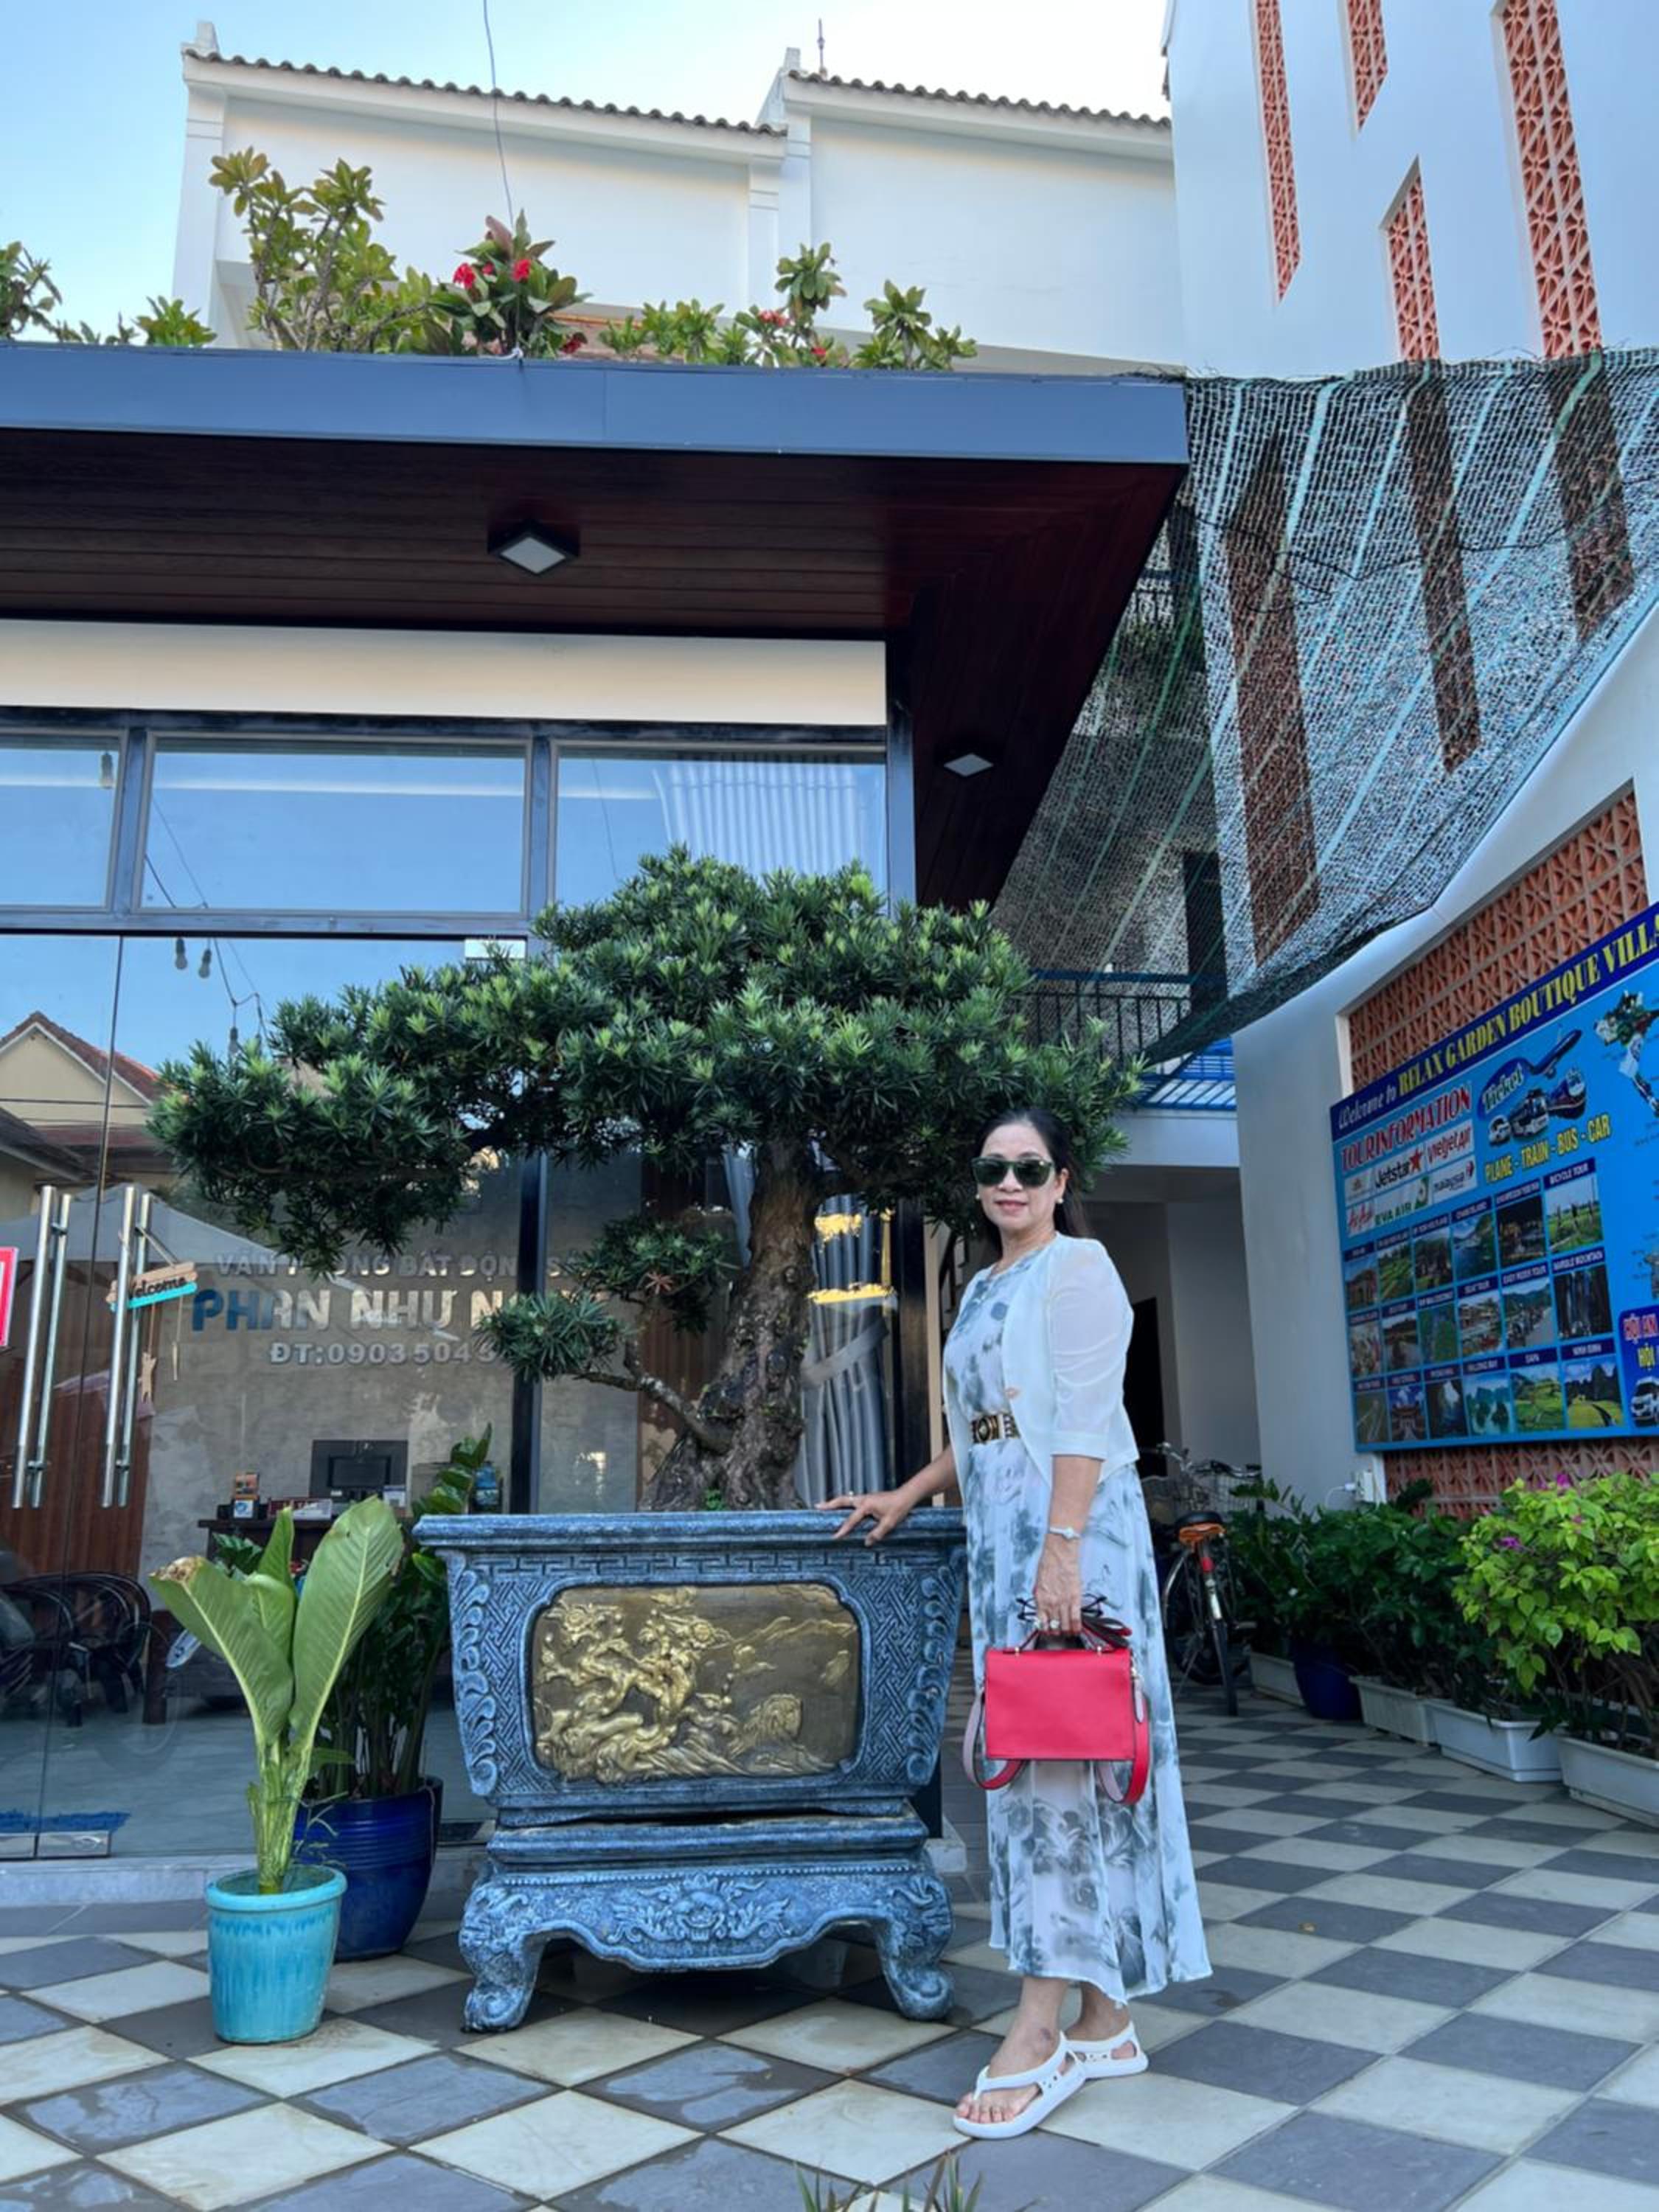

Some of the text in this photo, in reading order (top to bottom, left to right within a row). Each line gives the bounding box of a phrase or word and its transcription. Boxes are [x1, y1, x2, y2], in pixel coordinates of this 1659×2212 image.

[1399, 1050, 1444, 1096] RELAX
[1445, 1011, 1506, 1068] GARDEN
[1509, 953, 1601, 1032] BOUTIQUE
[1482, 1062, 1525, 1114] Ticket
[1485, 1155, 1512, 1183] PLANE
[1521, 1141, 1548, 1168] TRAIN
[1557, 1127, 1579, 1155] BUS
[1587, 1113, 1612, 1143] CAR
[459, 1250, 517, 1282] ĐỘN
[350, 1290, 458, 1329] NHƯ
